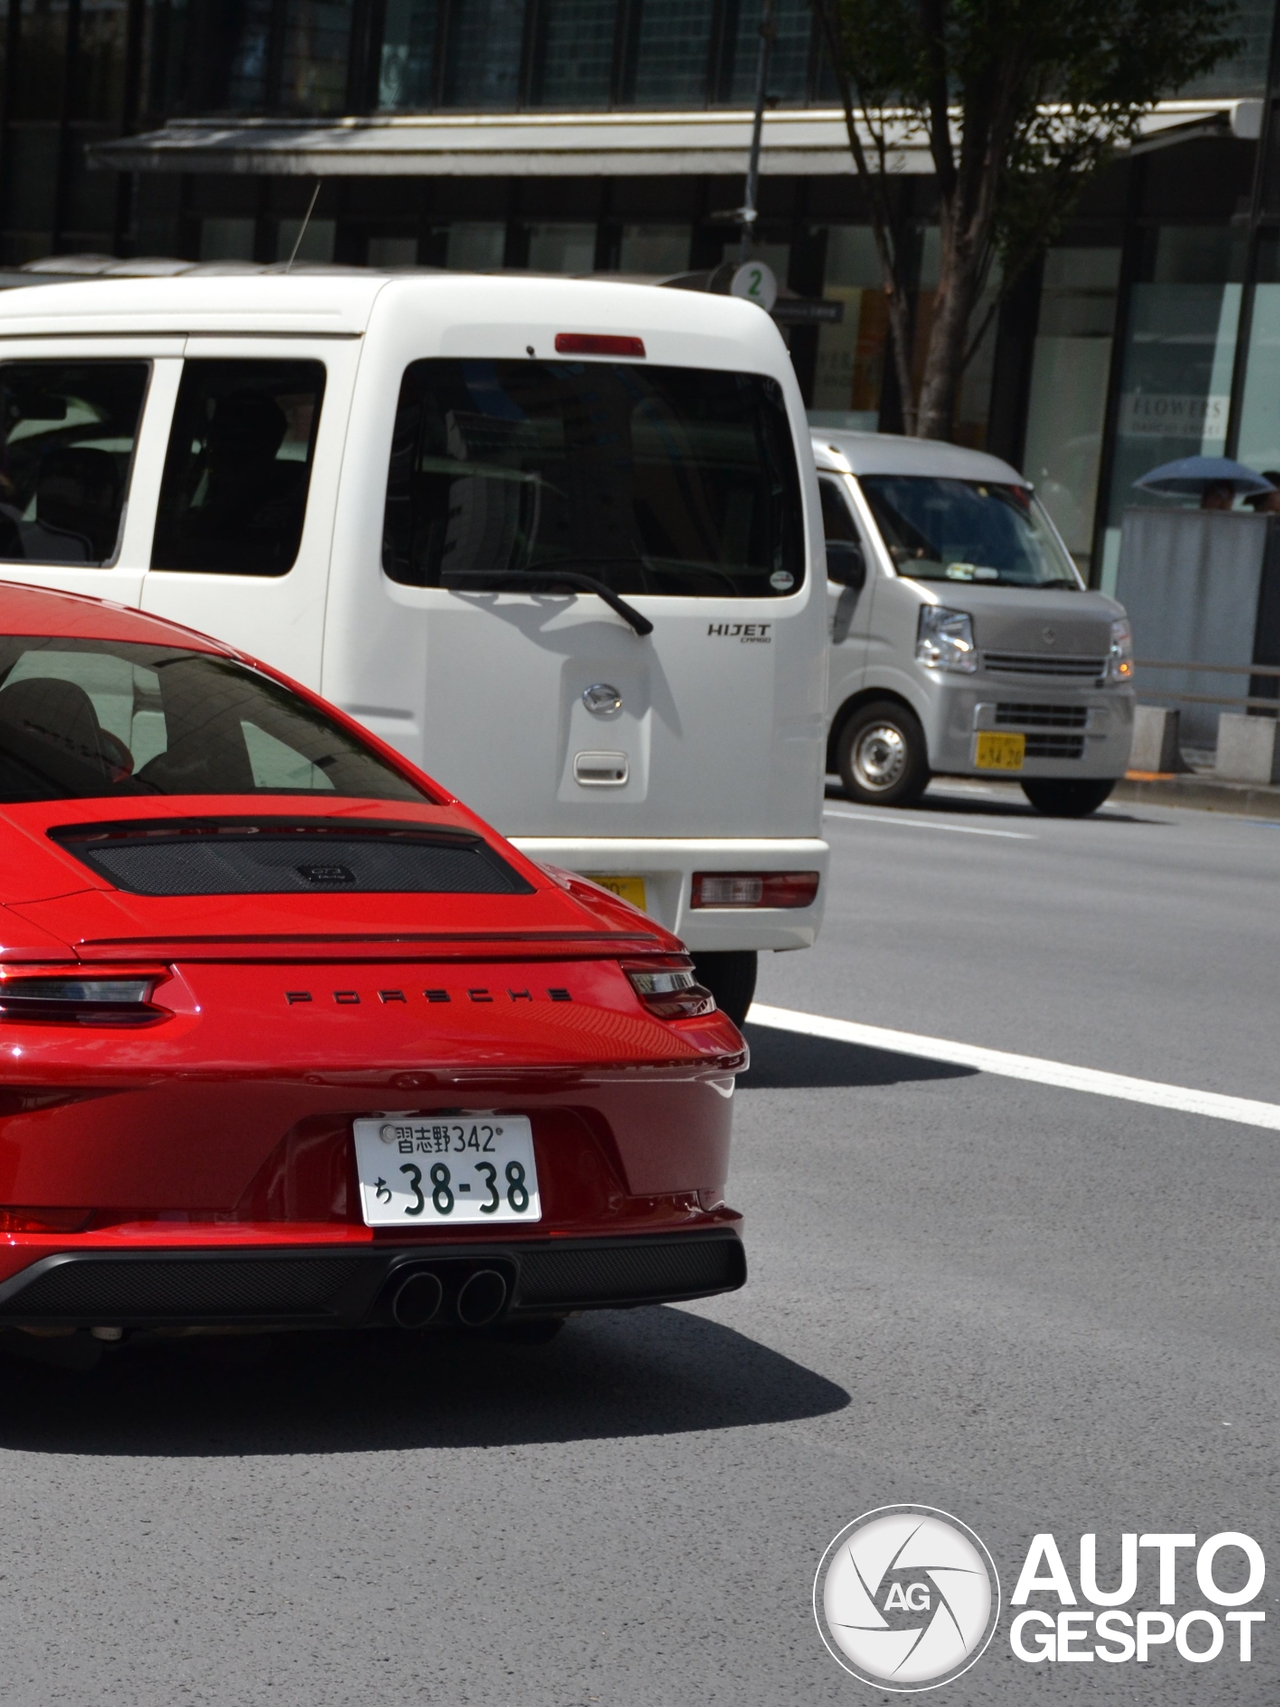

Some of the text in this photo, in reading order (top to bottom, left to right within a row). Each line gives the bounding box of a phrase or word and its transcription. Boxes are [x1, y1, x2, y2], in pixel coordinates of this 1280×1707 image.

[748, 269, 763, 296] 2
[1133, 398, 1222, 420] FLOWERS
[707, 624, 772, 636] HIJET
[284, 988, 572, 1005] PORSCHE
[374, 1161, 529, 1215] ち 38-38
